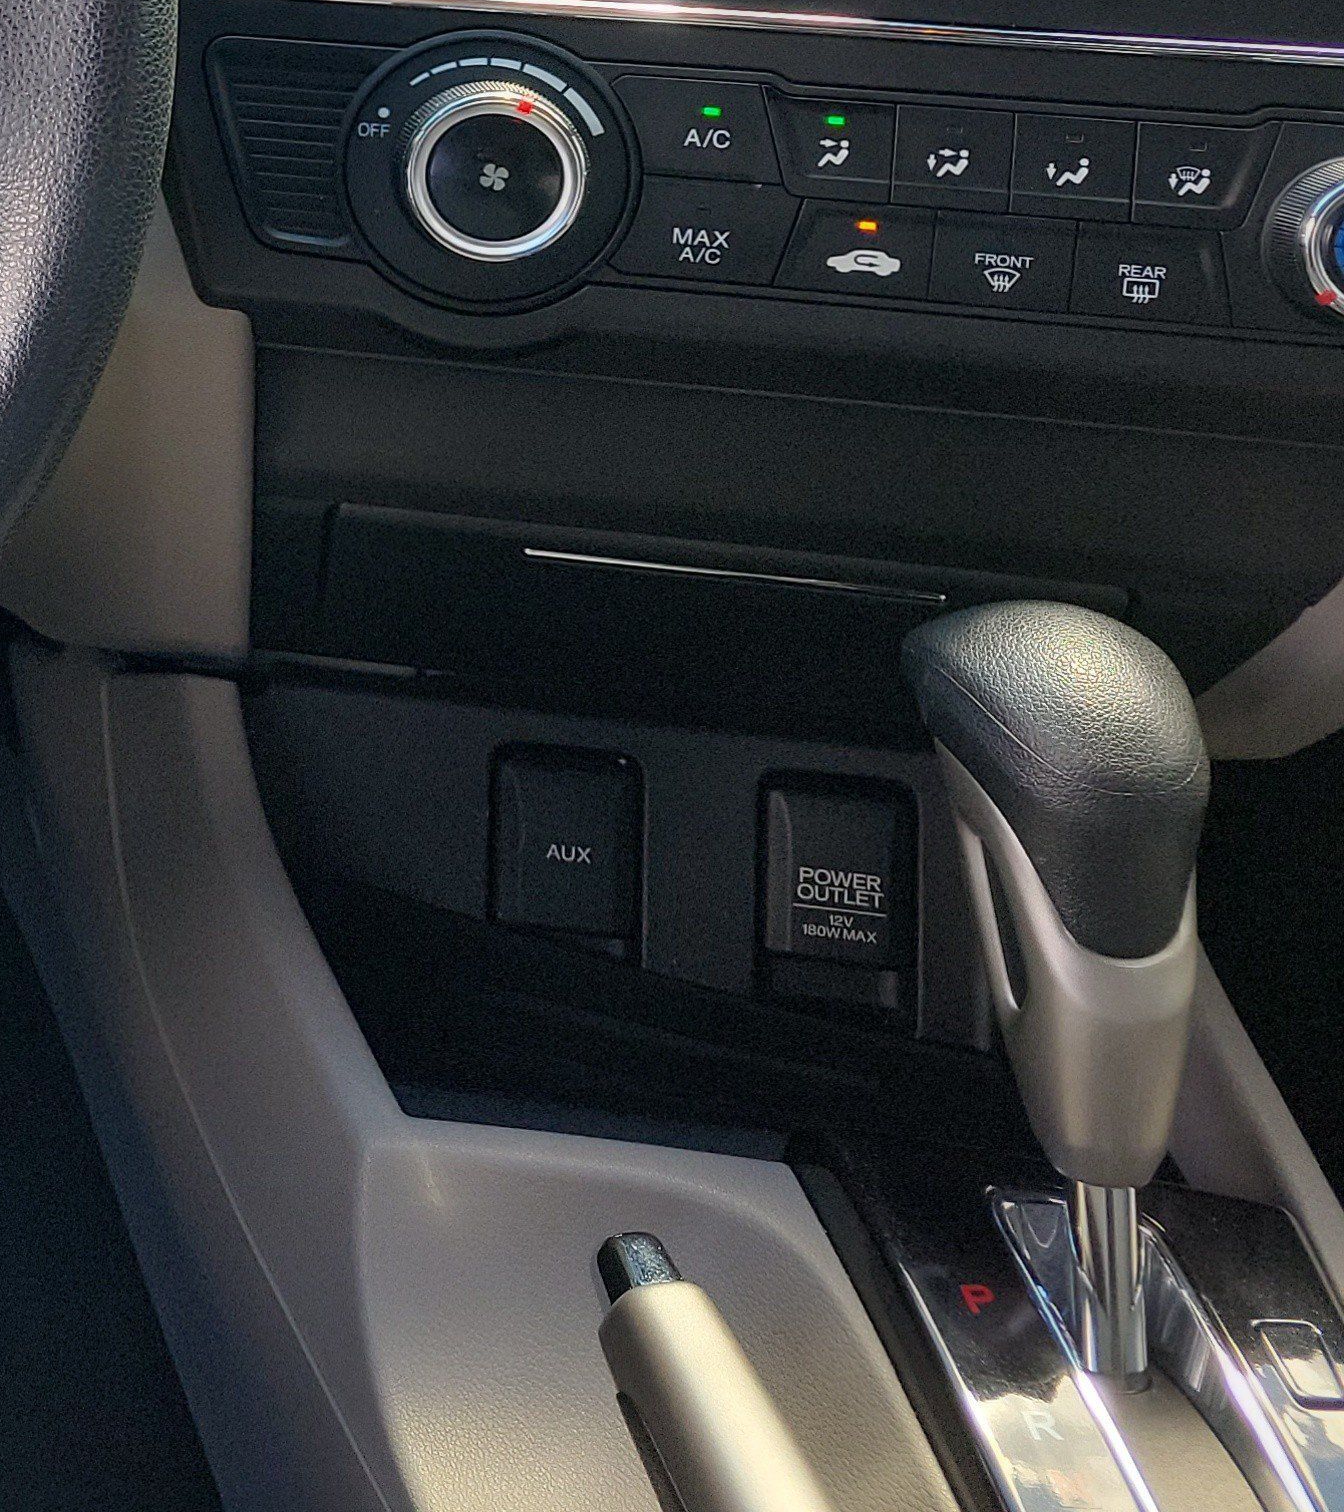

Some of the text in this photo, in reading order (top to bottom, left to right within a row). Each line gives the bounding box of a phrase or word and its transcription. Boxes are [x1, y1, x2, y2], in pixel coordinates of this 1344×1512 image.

[357, 122, 391, 139] OFF
[683, 128, 732, 150] A/C
[672, 227, 730, 248] MAX
[678, 245, 722, 266] A/C
[974, 252, 1034, 270] FRONT
[1118, 264, 1167, 280] REAR
[546, 843, 592, 865] AUX
[798, 866, 882, 892] POWER
[796, 882, 885, 909] OUTLET
[828, 914, 854, 929] 12V
[841, 927, 878, 945] MAX
[960, 1283, 996, 1316] P
[1021, 1410, 1064, 1442] R
